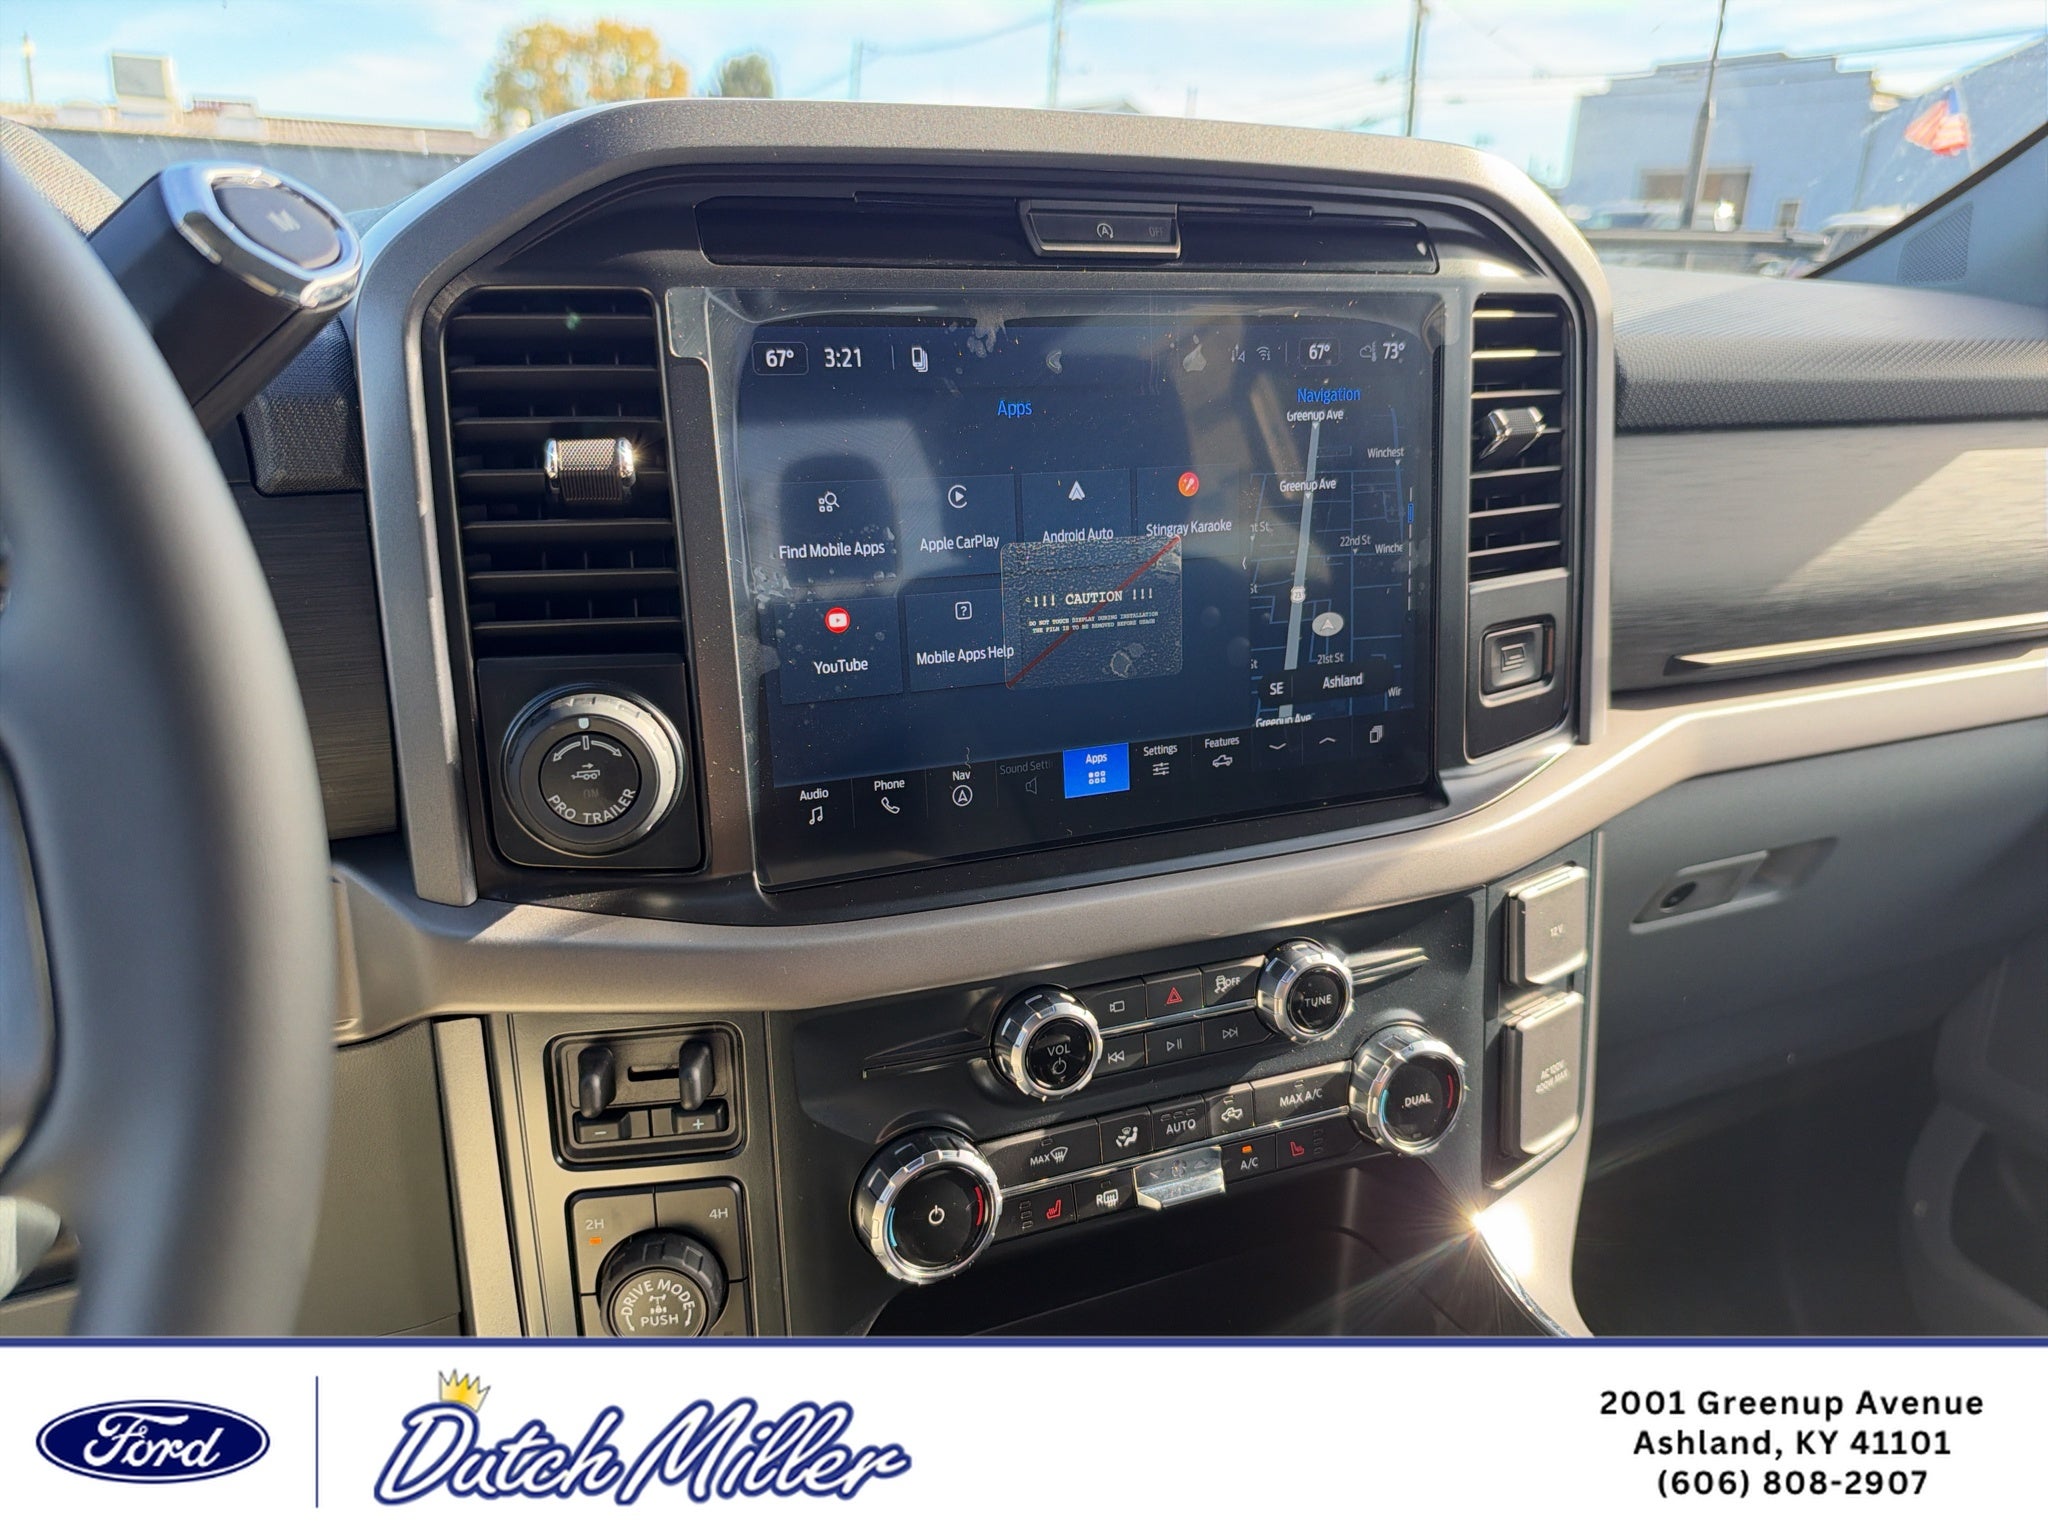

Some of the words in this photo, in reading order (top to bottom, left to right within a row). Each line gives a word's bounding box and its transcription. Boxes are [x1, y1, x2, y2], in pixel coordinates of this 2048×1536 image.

[824, 347, 863, 368] 3:21
[1297, 387, 1361, 404] Navigation
[997, 400, 1033, 418] Apps
[1287, 410, 1325, 423] Greenup
[1326, 409, 1344, 421] Ave
[1367, 447, 1405, 459] Winchest
[1279, 479, 1318, 492] Greenup
[1319, 478, 1337, 490] Ave
[1042, 529, 1086, 544] Android
[1087, 527, 1114, 542] Auto
[1146, 522, 1189, 538] Stingray
[1191, 519, 1232, 533] Karaoke
[920, 536, 953, 553] Apple
[956, 534, 1000, 551] CarPlay
[1340, 535, 1361, 547] 22nd
[1361, 534, 1371, 545] St
[779, 545, 807, 560] Find
[809, 543, 851, 558] Mobile
[854, 541, 885, 558] Apps
[1065, 590, 1123, 605] CAUTION
[916, 650, 955, 666] Mobile
[957, 647, 986, 663] Apps
[988, 644, 1014, 660] Help
[1317, 653, 1333, 665] 21st
[1334, 652, 1344, 663] St
[813, 658, 869, 675] YouTube
[1322, 672, 1363, 689] Ashland
[1269, 682, 1284, 695] SE
[1204, 735, 1240, 749] Features
[1143, 743, 1178, 757] Settings
[1085, 753, 1108, 765] Apps
[952, 769, 971, 781] Nav
[1000, 761, 1028, 775] Sound
[874, 777, 905, 791] Phone
[800, 787, 829, 801] Audio
[548, 794, 577, 819] PRO
[583, 788, 636, 824] TRAILER
[1224, 975, 1241, 987] OFF
[1304, 994, 1332, 1007] TUNE
[1047, 1044, 1071, 1057] VOL
[1279, 1093, 1303, 1107] MAX
[1305, 1088, 1323, 1101] A/C
[1404, 1092, 1431, 1106] DUAL
[1166, 1119, 1196, 1135] AUTO
[1030, 1153, 1050, 1167] MAX
[1240, 1157, 1259, 1170] A/C
[709, 1208, 729, 1219] 4H
[585, 1219, 605, 1230] 2H
[621, 1280, 654, 1316] DRIVE
[657, 1279, 695, 1311] MODE
[641, 1314, 679, 1327] PUSH
